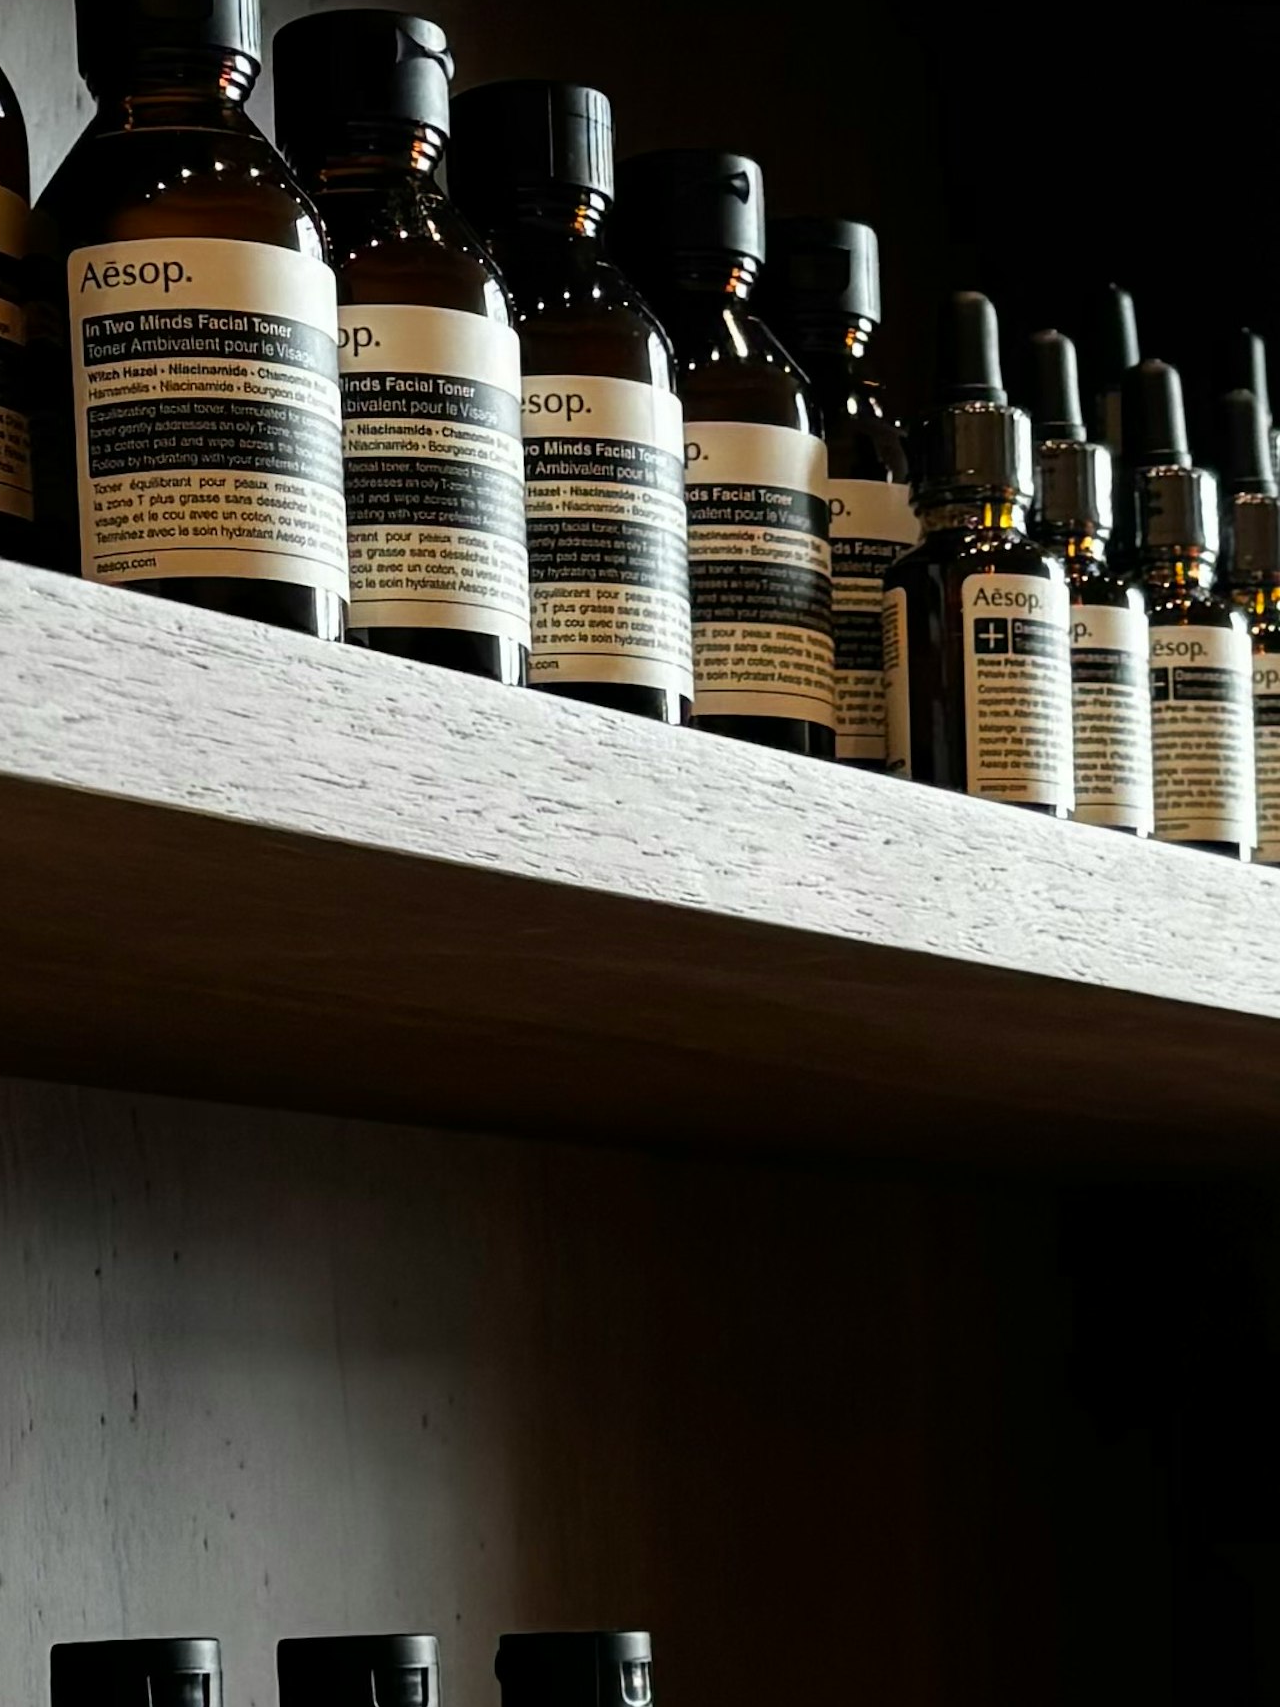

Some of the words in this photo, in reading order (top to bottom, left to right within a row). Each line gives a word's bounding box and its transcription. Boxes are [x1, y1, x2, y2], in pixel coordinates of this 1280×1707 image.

[80, 260, 193, 293] Aēsop.
[85, 323, 101, 338] In
[102, 320, 135, 336] Two
[139, 315, 194, 332] Minds
[198, 315, 249, 332] Facial
[254, 318, 293, 339] Toner
[87, 341, 127, 359] Toner
[131, 335, 220, 353] Ambivalent
[224, 339, 259, 356] pour
[385, 377, 433, 394] Facial
[438, 380, 476, 399] Toner
[973, 586, 1042, 613] Aēsop.
